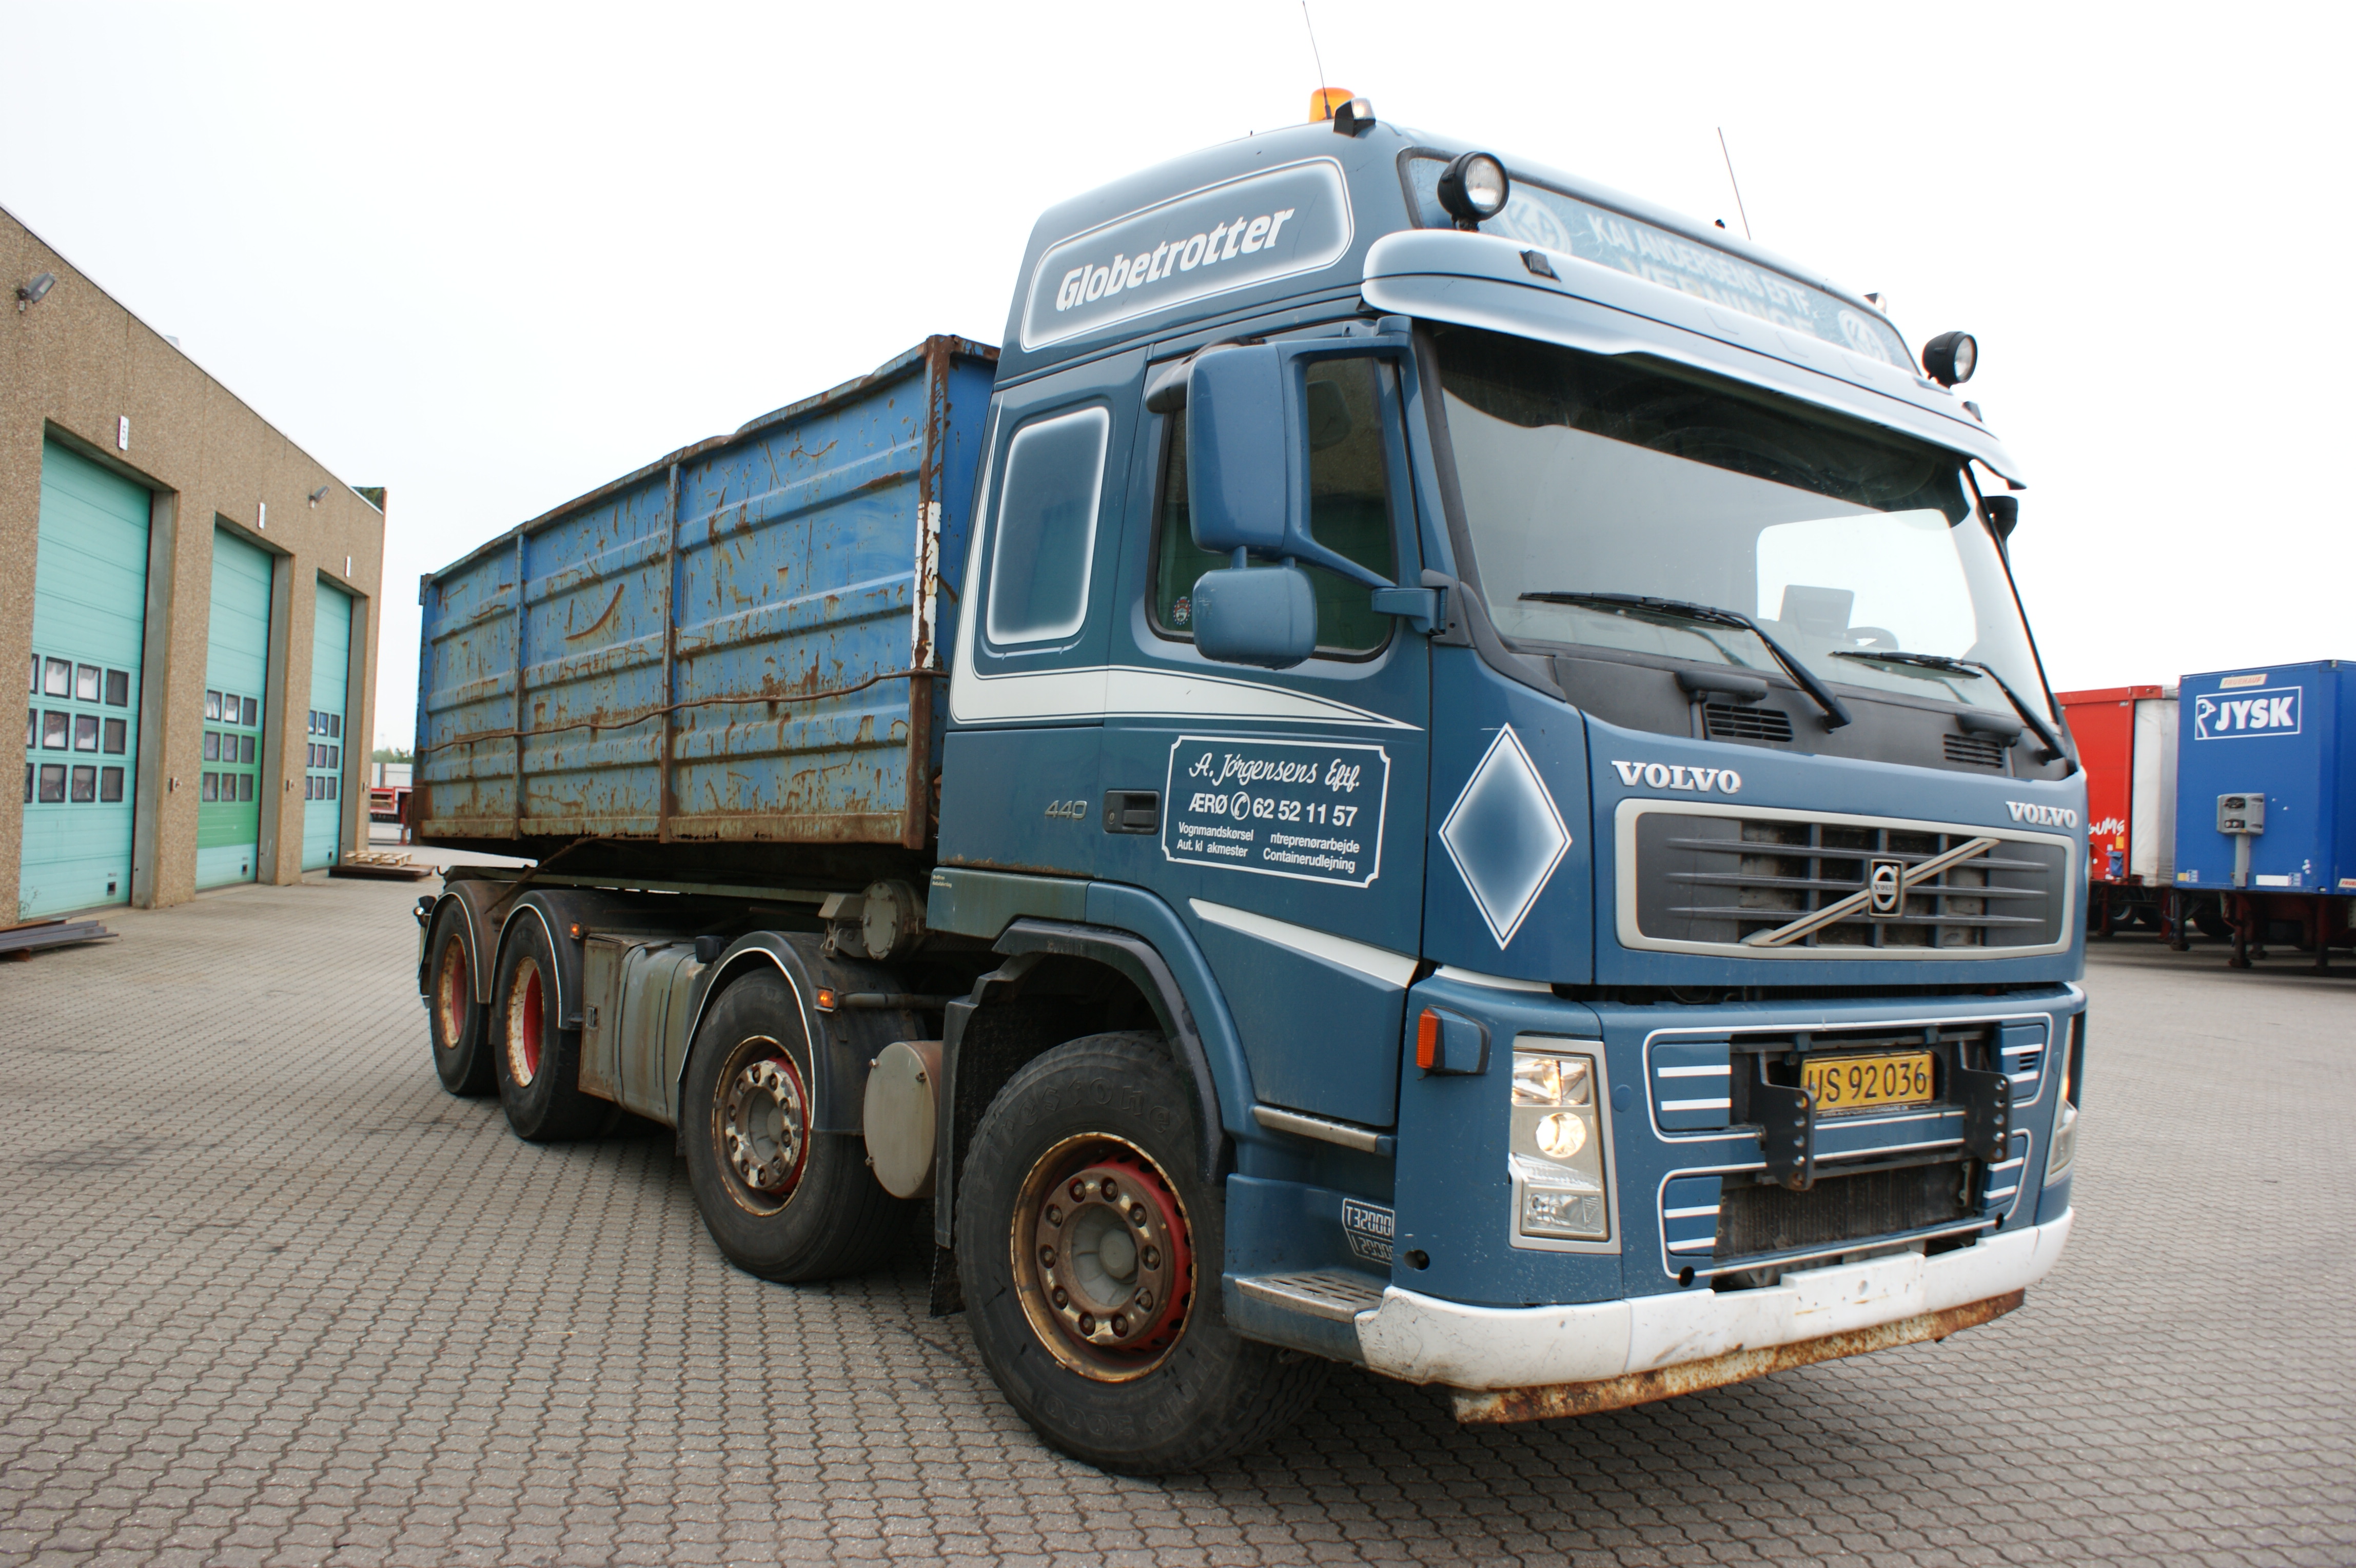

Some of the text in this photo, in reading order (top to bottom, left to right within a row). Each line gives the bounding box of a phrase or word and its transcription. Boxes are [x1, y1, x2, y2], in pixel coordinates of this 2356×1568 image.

[1056, 208, 1294, 311] Globetrotter
[1586, 212, 1636, 252] KAI
[1635, 228, 1765, 298] ANDERSENS
[2214, 696, 2295, 731] JYSK
[1189, 752, 1214, 777] A.
[1325, 758, 1360, 793] Eftf.
[1611, 760, 1741, 794] VOLVO
[1045, 800, 1087, 819] 440
[1188, 793, 1358, 827] ÆRØ 62 52 11 57
[2005, 800, 2078, 829] VOLVO
[1176, 839, 1193, 851] Aut.
[1178, 821, 1254, 841] Vognmandskørsel
[1270, 832, 1360, 855] ntreprenørarbejde
[1263, 847, 1356, 874] Containerudlejning
[1808, 1062, 1927, 1103] US 92 036
[1346, 1206, 1391, 1237] T32000
